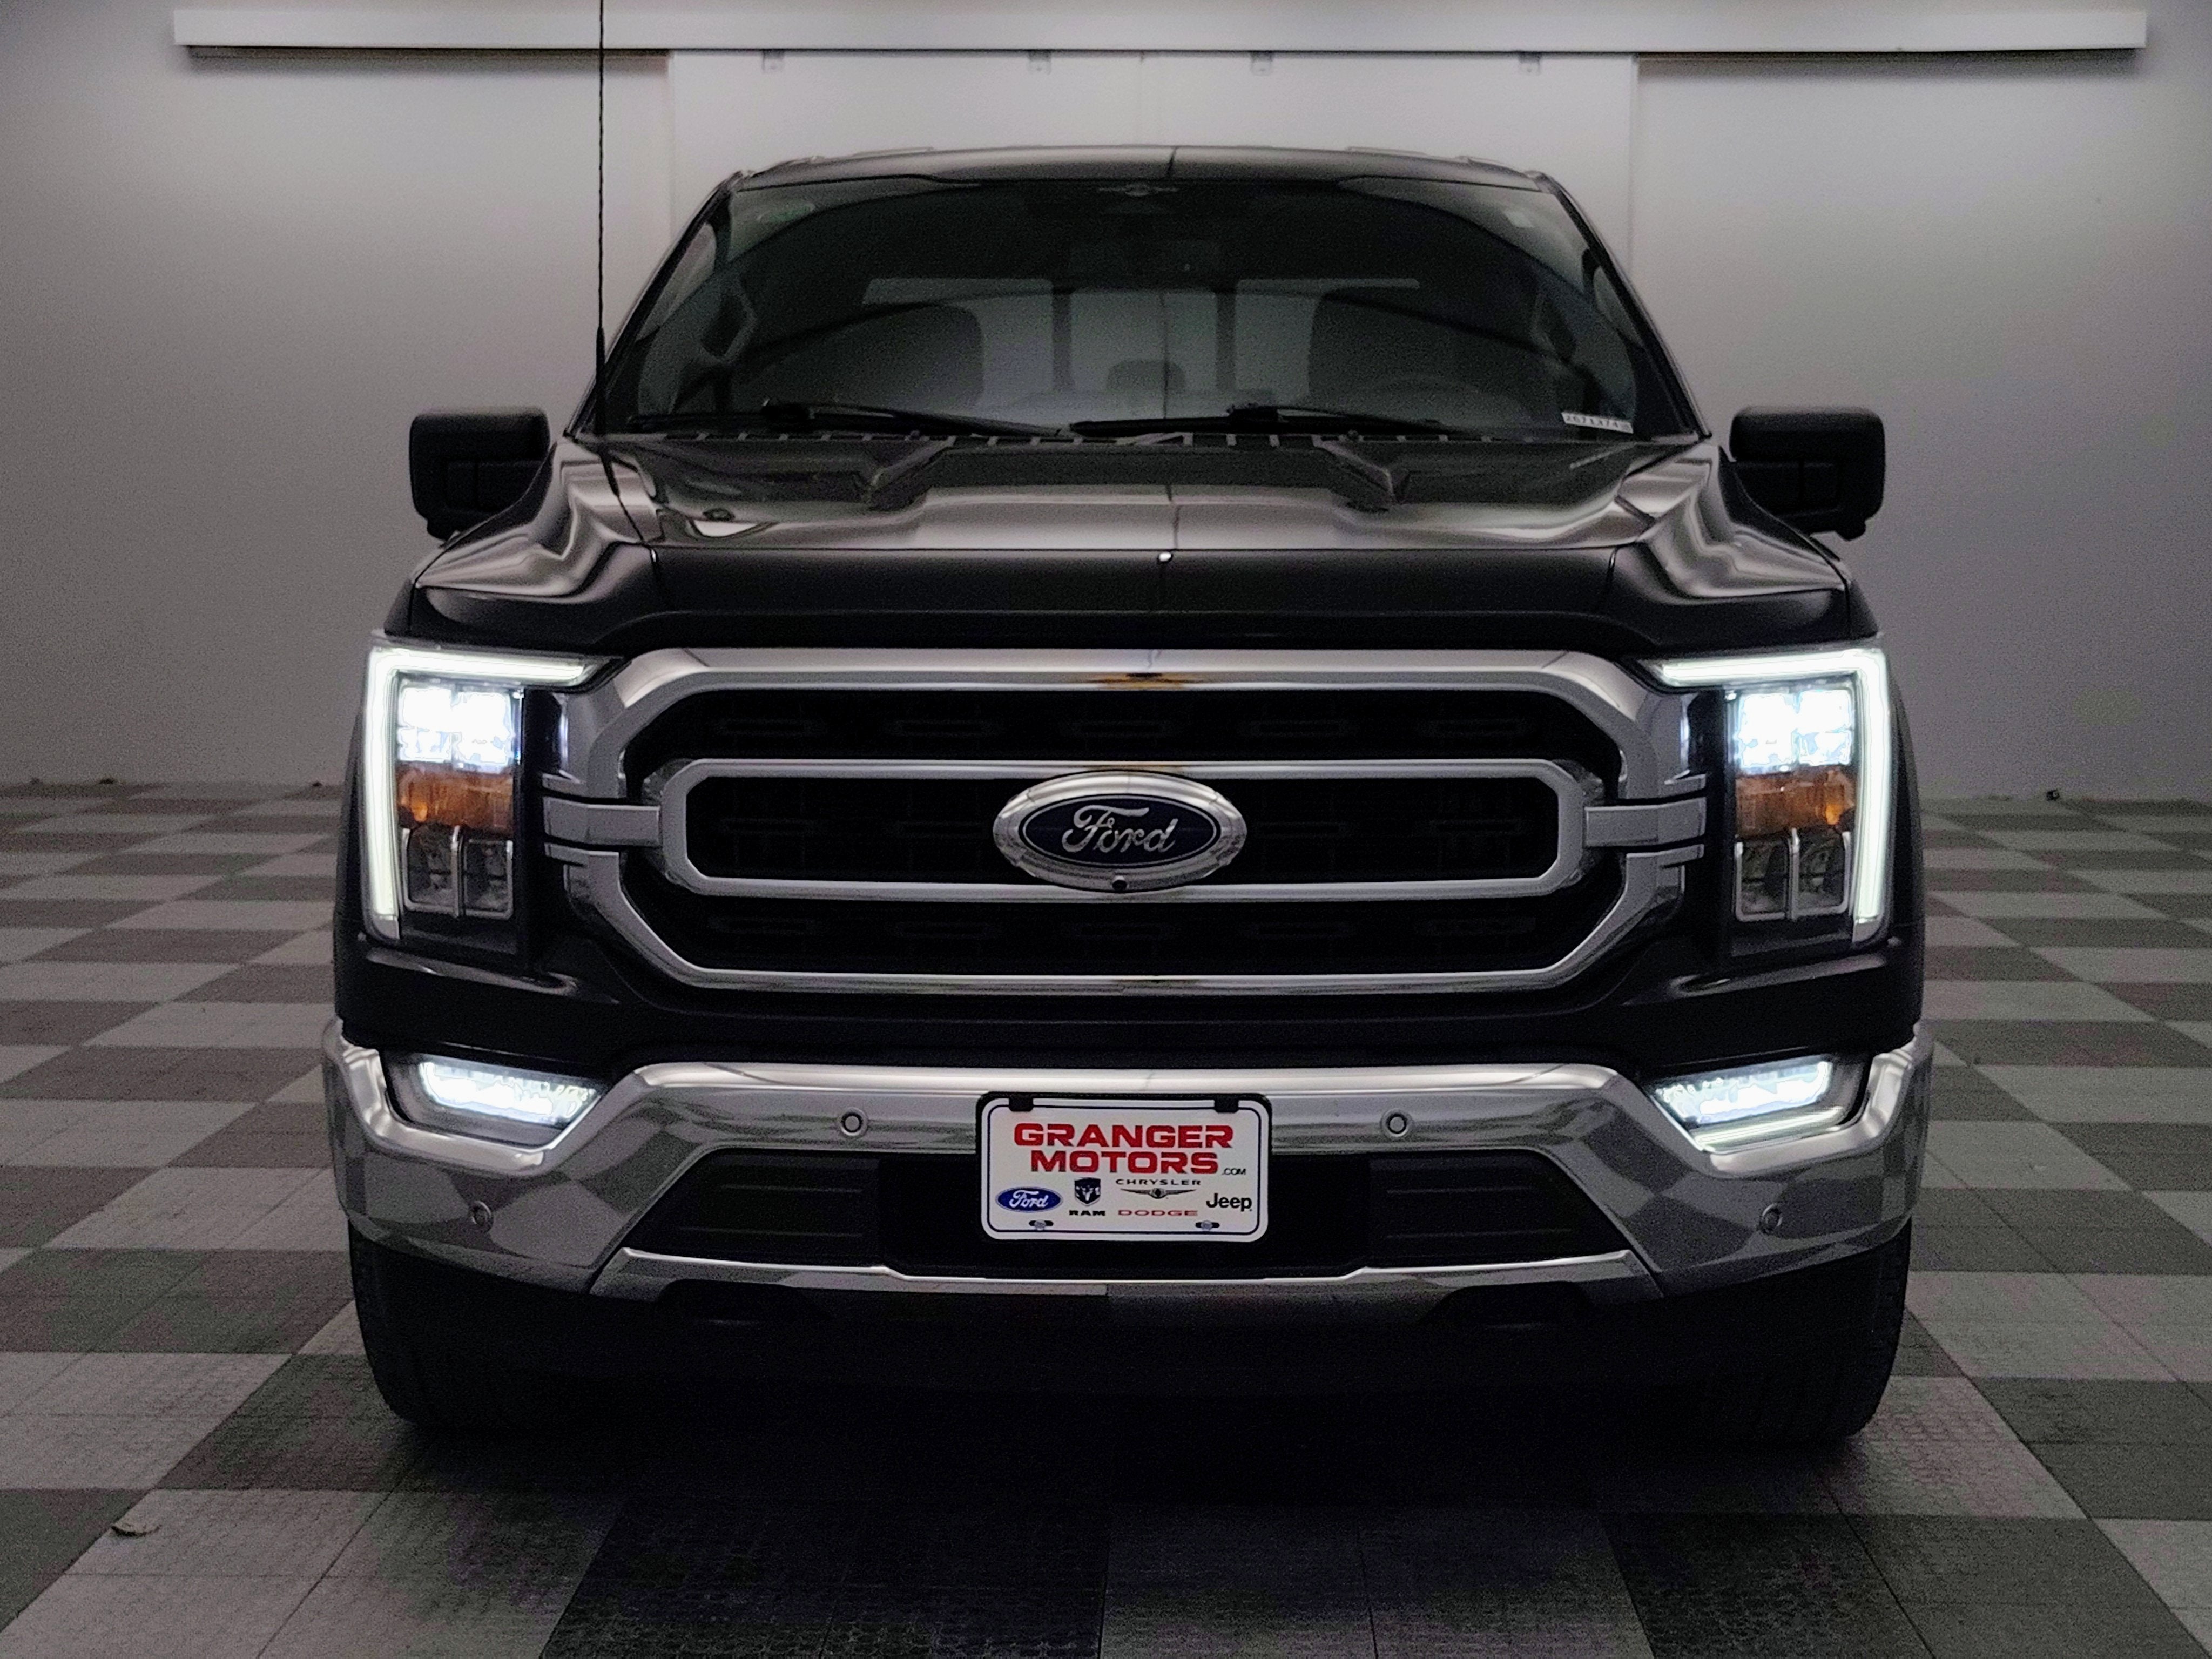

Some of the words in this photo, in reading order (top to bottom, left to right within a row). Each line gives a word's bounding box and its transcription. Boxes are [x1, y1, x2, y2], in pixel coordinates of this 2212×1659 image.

[1062, 804, 1178, 853] Ford
[1014, 1123, 1233, 1148] GRANGER
[1030, 1150, 1219, 1174] MOTORS
[1115, 1178, 1202, 1186] CHRYSLER
[1008, 1190, 1049, 1210] Ford
[1206, 1192, 1251, 1211] Jeep
